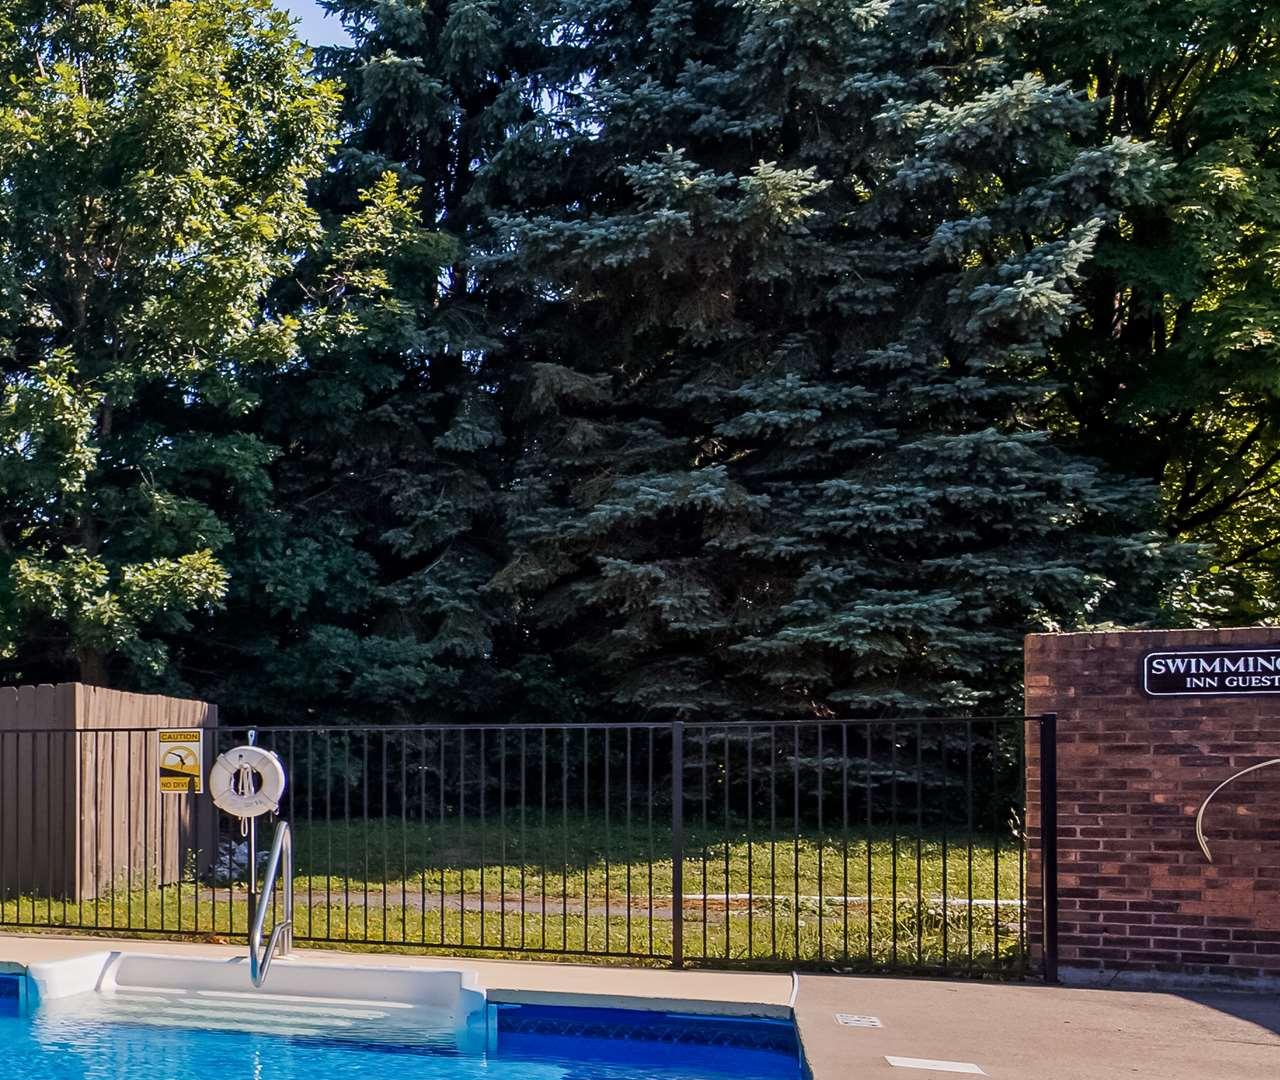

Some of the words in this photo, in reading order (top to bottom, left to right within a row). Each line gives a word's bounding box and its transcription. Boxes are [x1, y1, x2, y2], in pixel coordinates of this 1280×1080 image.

[1151, 656, 1280, 674] SWIMMIN
[1186, 677, 1218, 688] INN
[161, 781, 172, 789] NO
